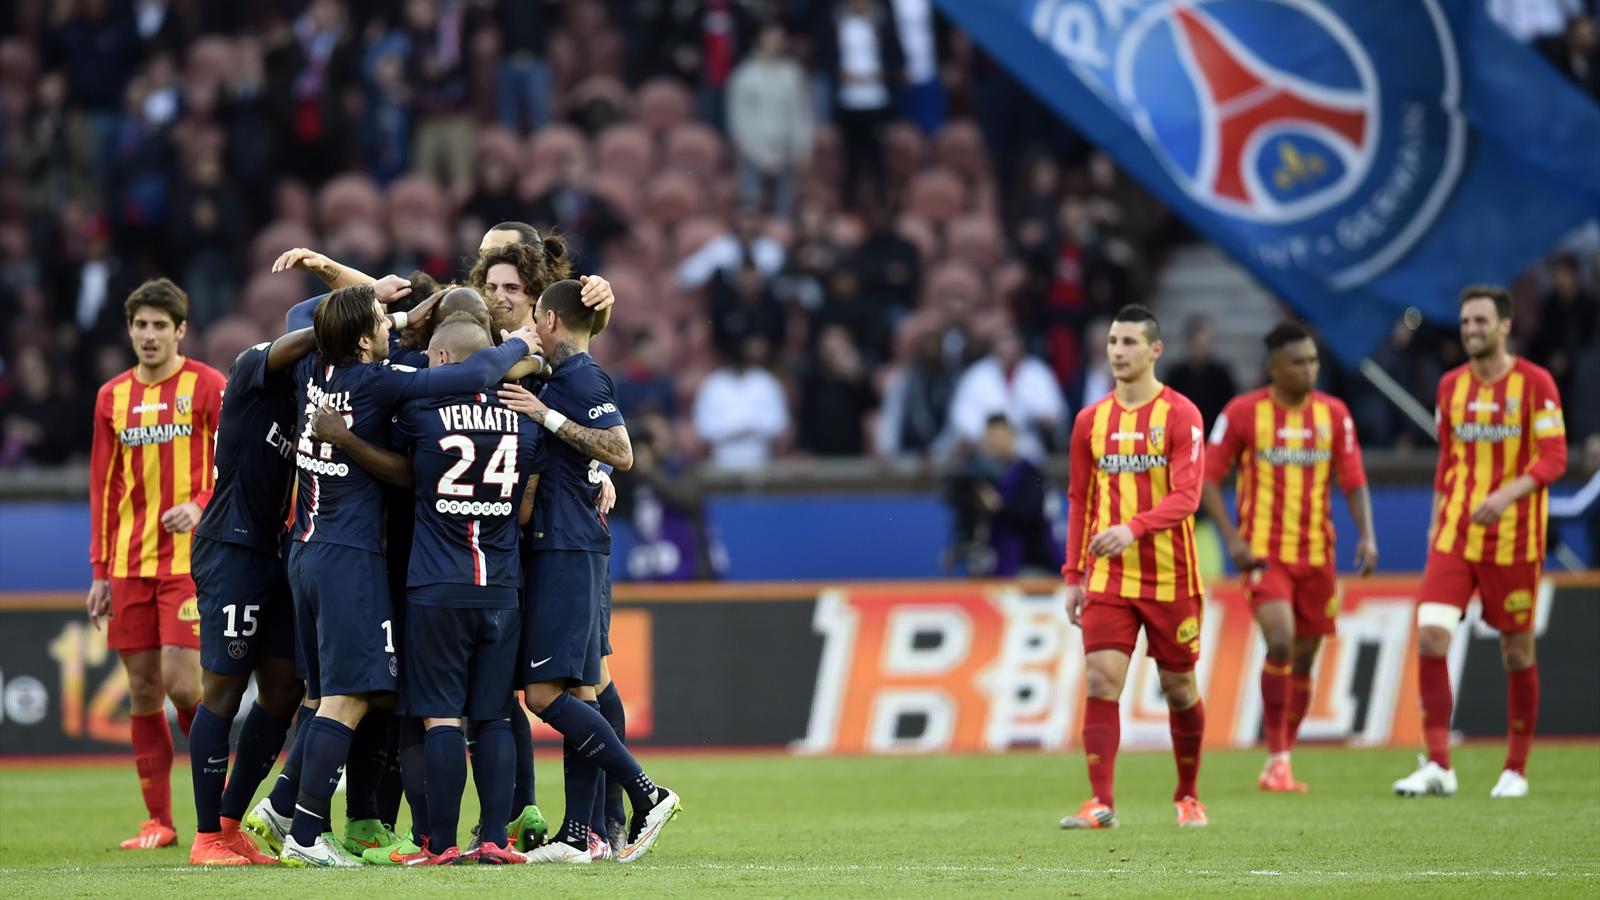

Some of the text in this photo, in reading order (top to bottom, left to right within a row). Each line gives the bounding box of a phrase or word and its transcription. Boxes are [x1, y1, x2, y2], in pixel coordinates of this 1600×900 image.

[438, 404, 519, 433] VERRATTI
[588, 402, 617, 420] QNB
[437, 434, 520, 498] 24
[435, 498, 512, 516] ooredoo
[222, 604, 260, 637] 15
[380, 619, 395, 653] 1
